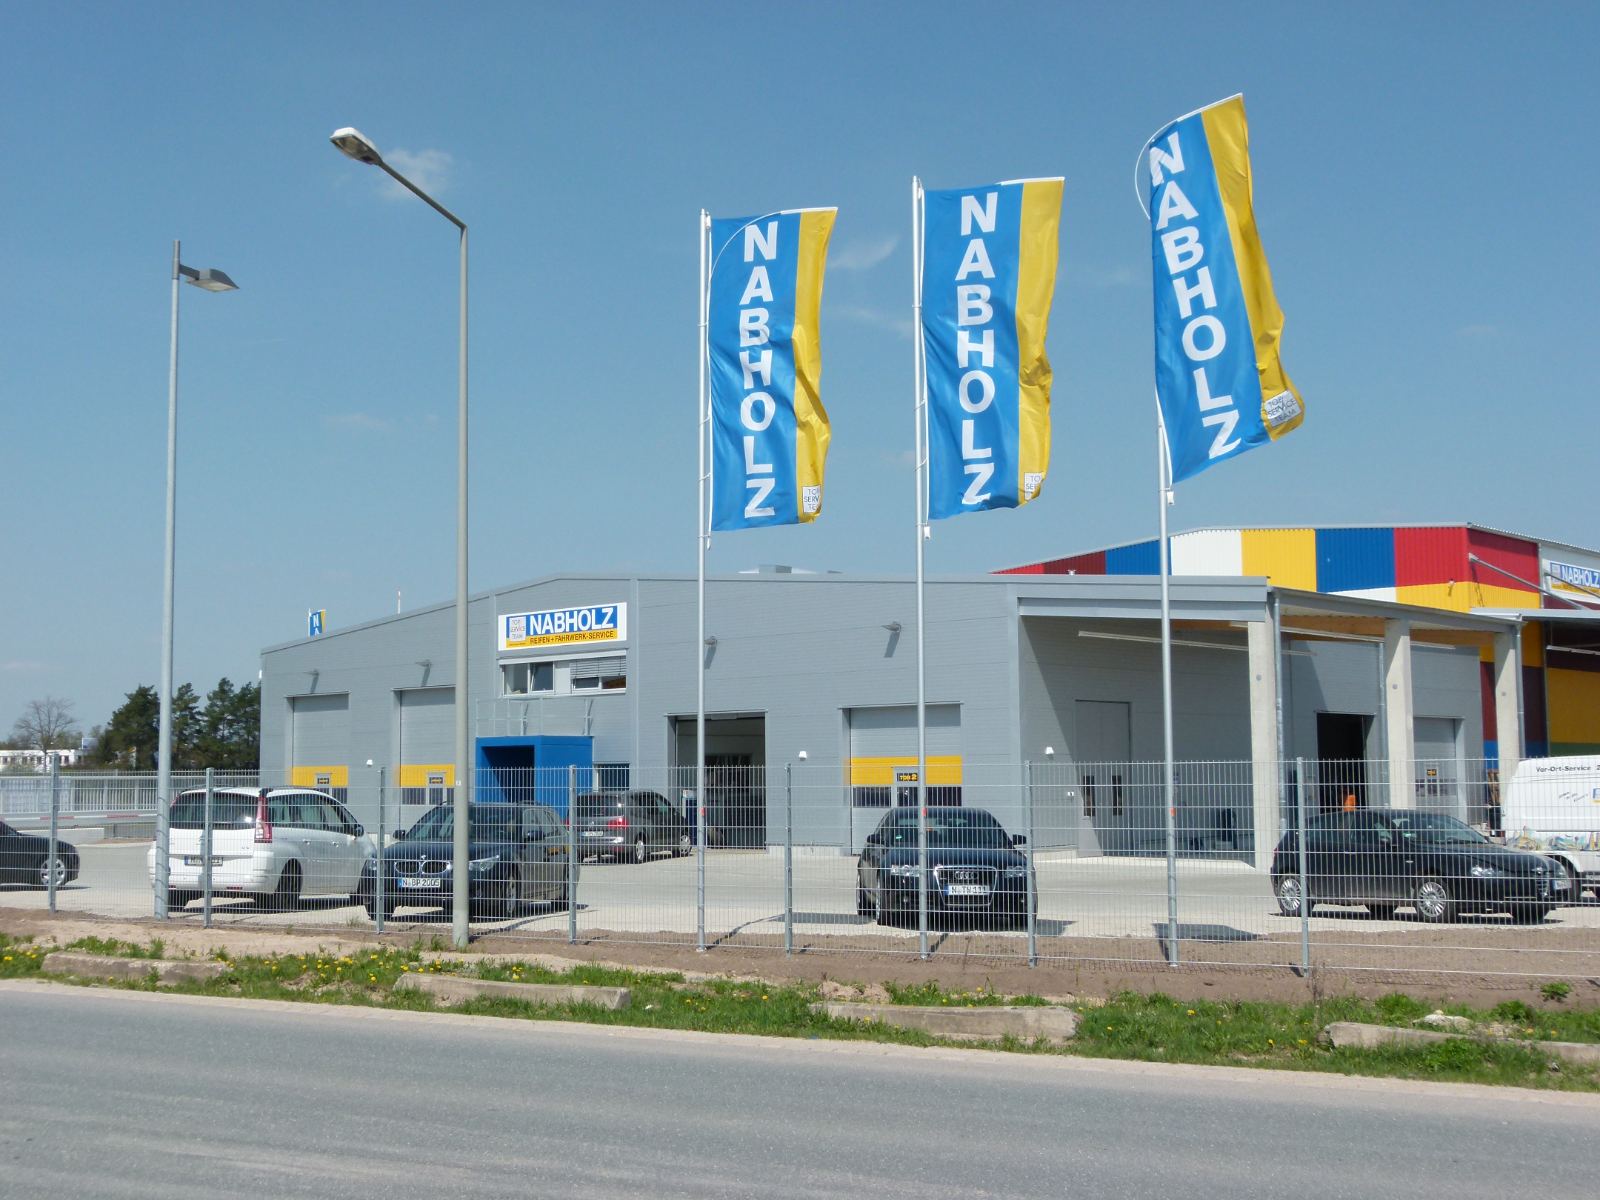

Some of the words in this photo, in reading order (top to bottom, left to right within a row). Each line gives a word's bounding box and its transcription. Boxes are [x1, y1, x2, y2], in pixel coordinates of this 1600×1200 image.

[739, 221, 778, 519] NABHOLZ
[954, 191, 999, 506] NABHOLZ
[1148, 131, 1241, 460] NABHOLZ
[529, 607, 614, 636] NABHOLZ
[1561, 565, 1600, 588] NABHOLZ
